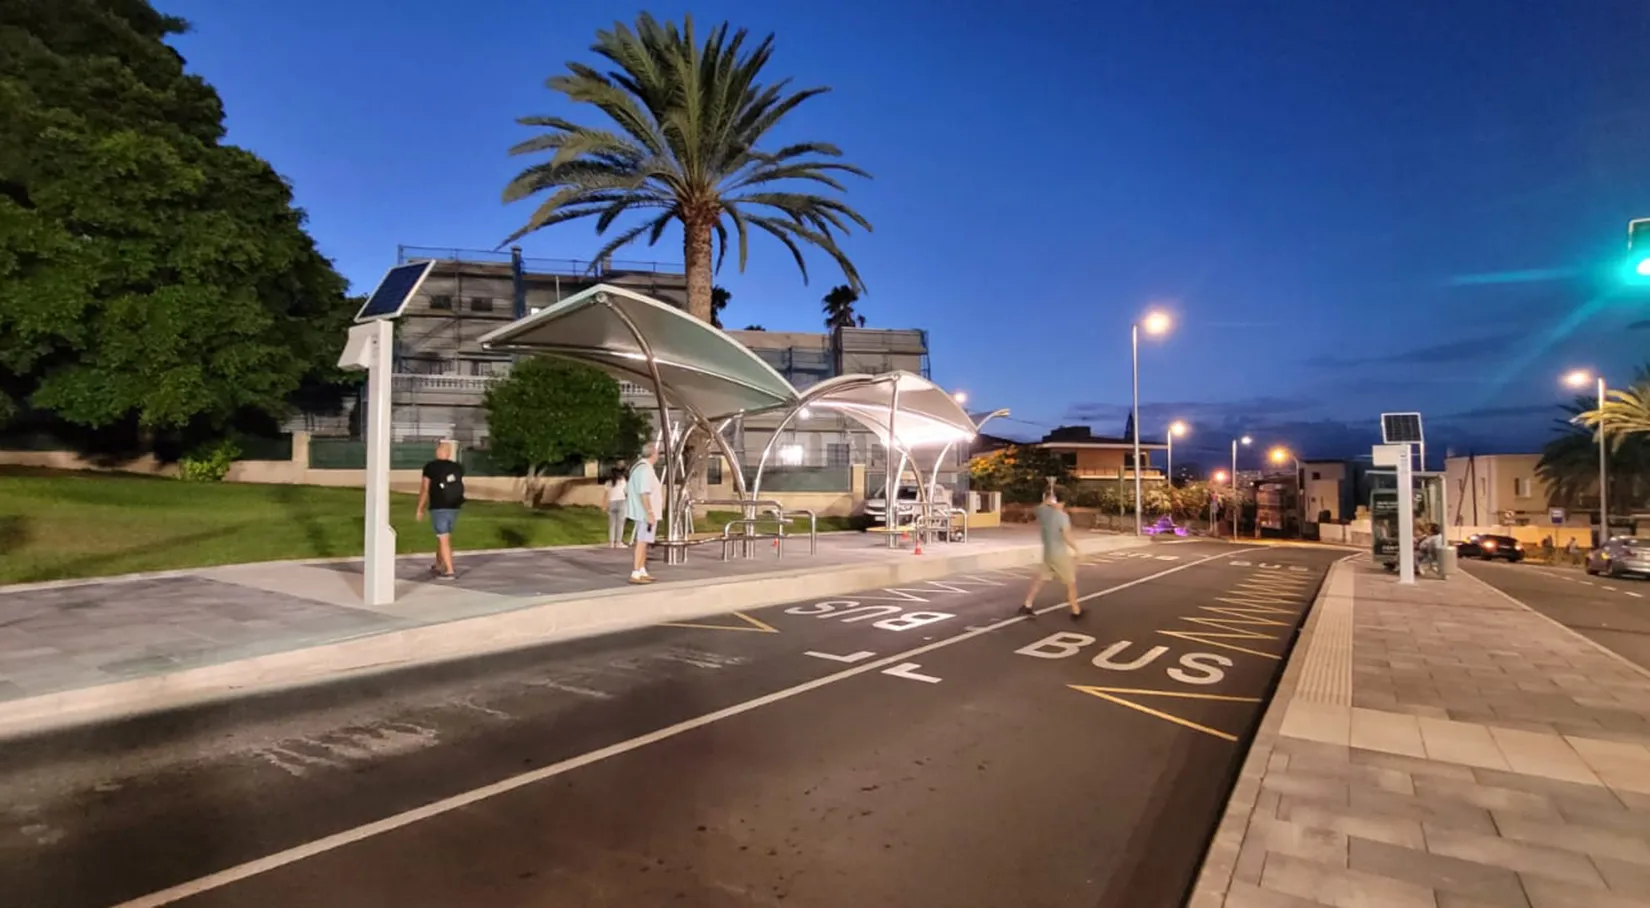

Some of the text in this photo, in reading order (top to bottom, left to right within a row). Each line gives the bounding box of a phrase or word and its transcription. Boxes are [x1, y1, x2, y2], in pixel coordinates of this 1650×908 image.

[1229, 561, 1309, 571] BUS
[784, 600, 957, 631] BUS
[1014, 631, 1233, 684] BUS
